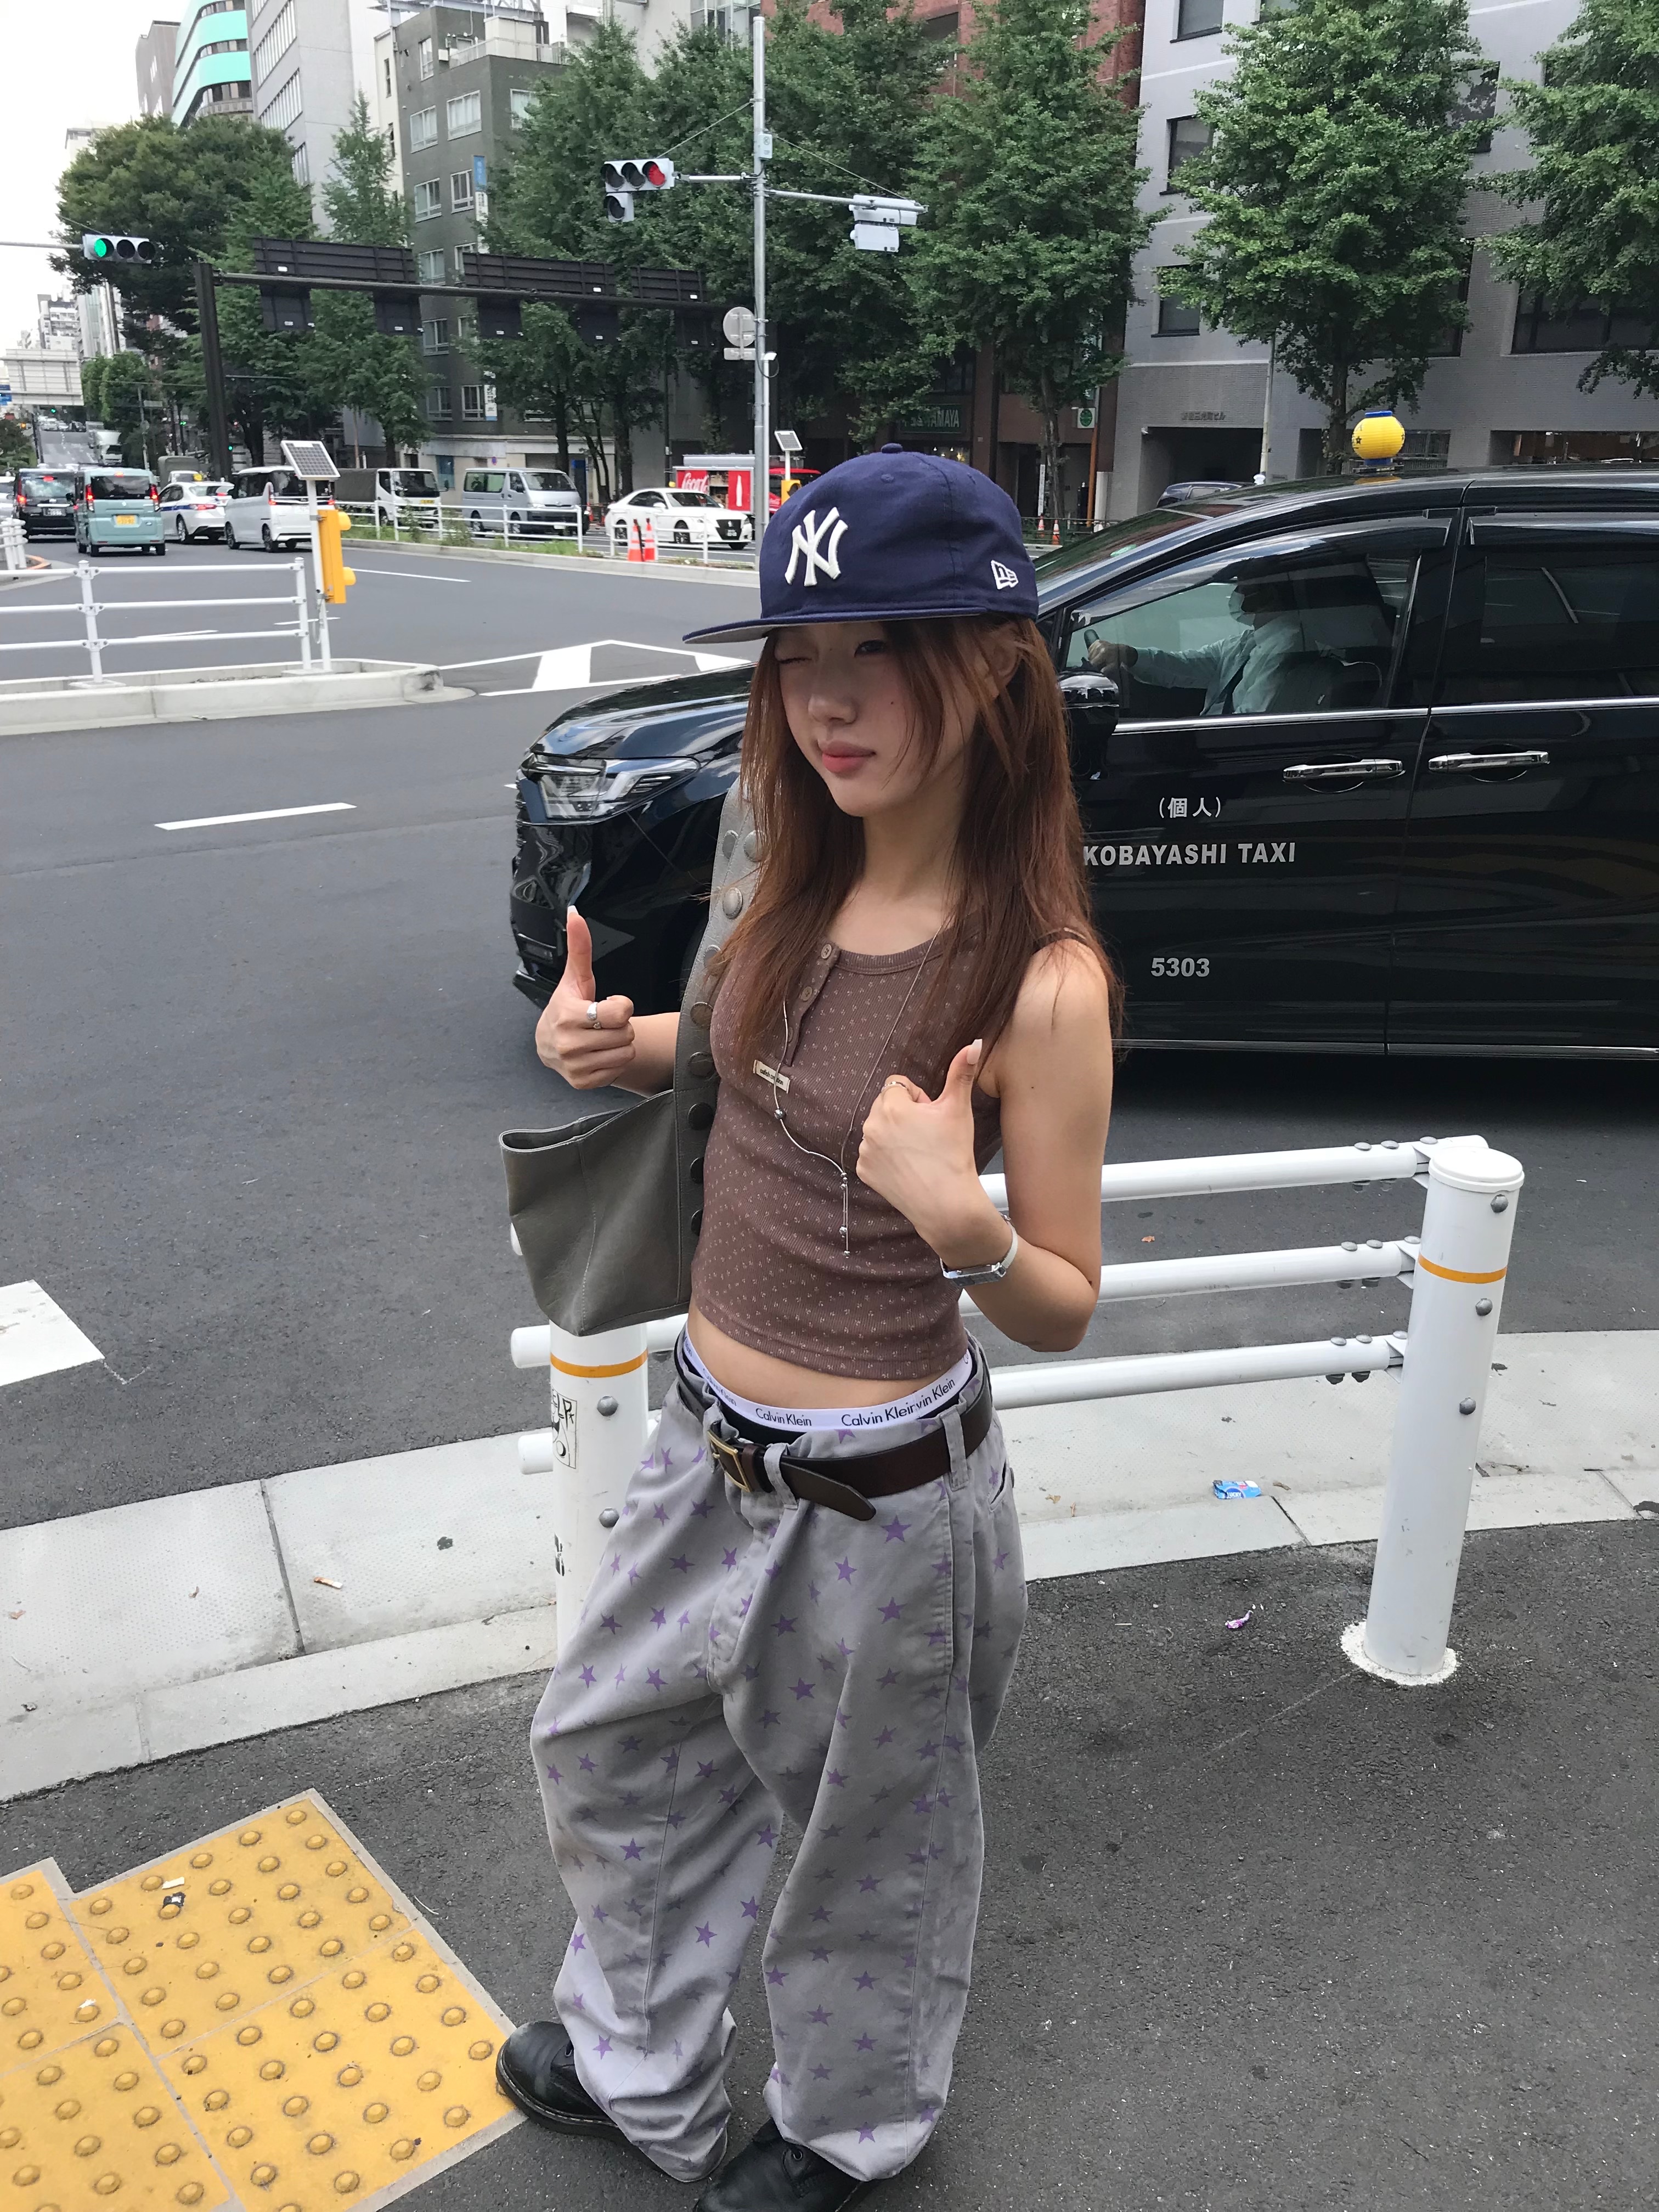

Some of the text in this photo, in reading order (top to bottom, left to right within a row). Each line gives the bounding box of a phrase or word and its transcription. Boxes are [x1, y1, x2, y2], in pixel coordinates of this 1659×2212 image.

[785, 506, 849, 586] NY
[1084, 842, 1295, 866] KOBAYASHI TAXI
[1150, 957, 1210, 977] 5303
[932, 1378, 955, 1400] Klein
[755, 1408, 812, 1426] Calvin Klein
[841, 1412, 883, 1426] Calvin
